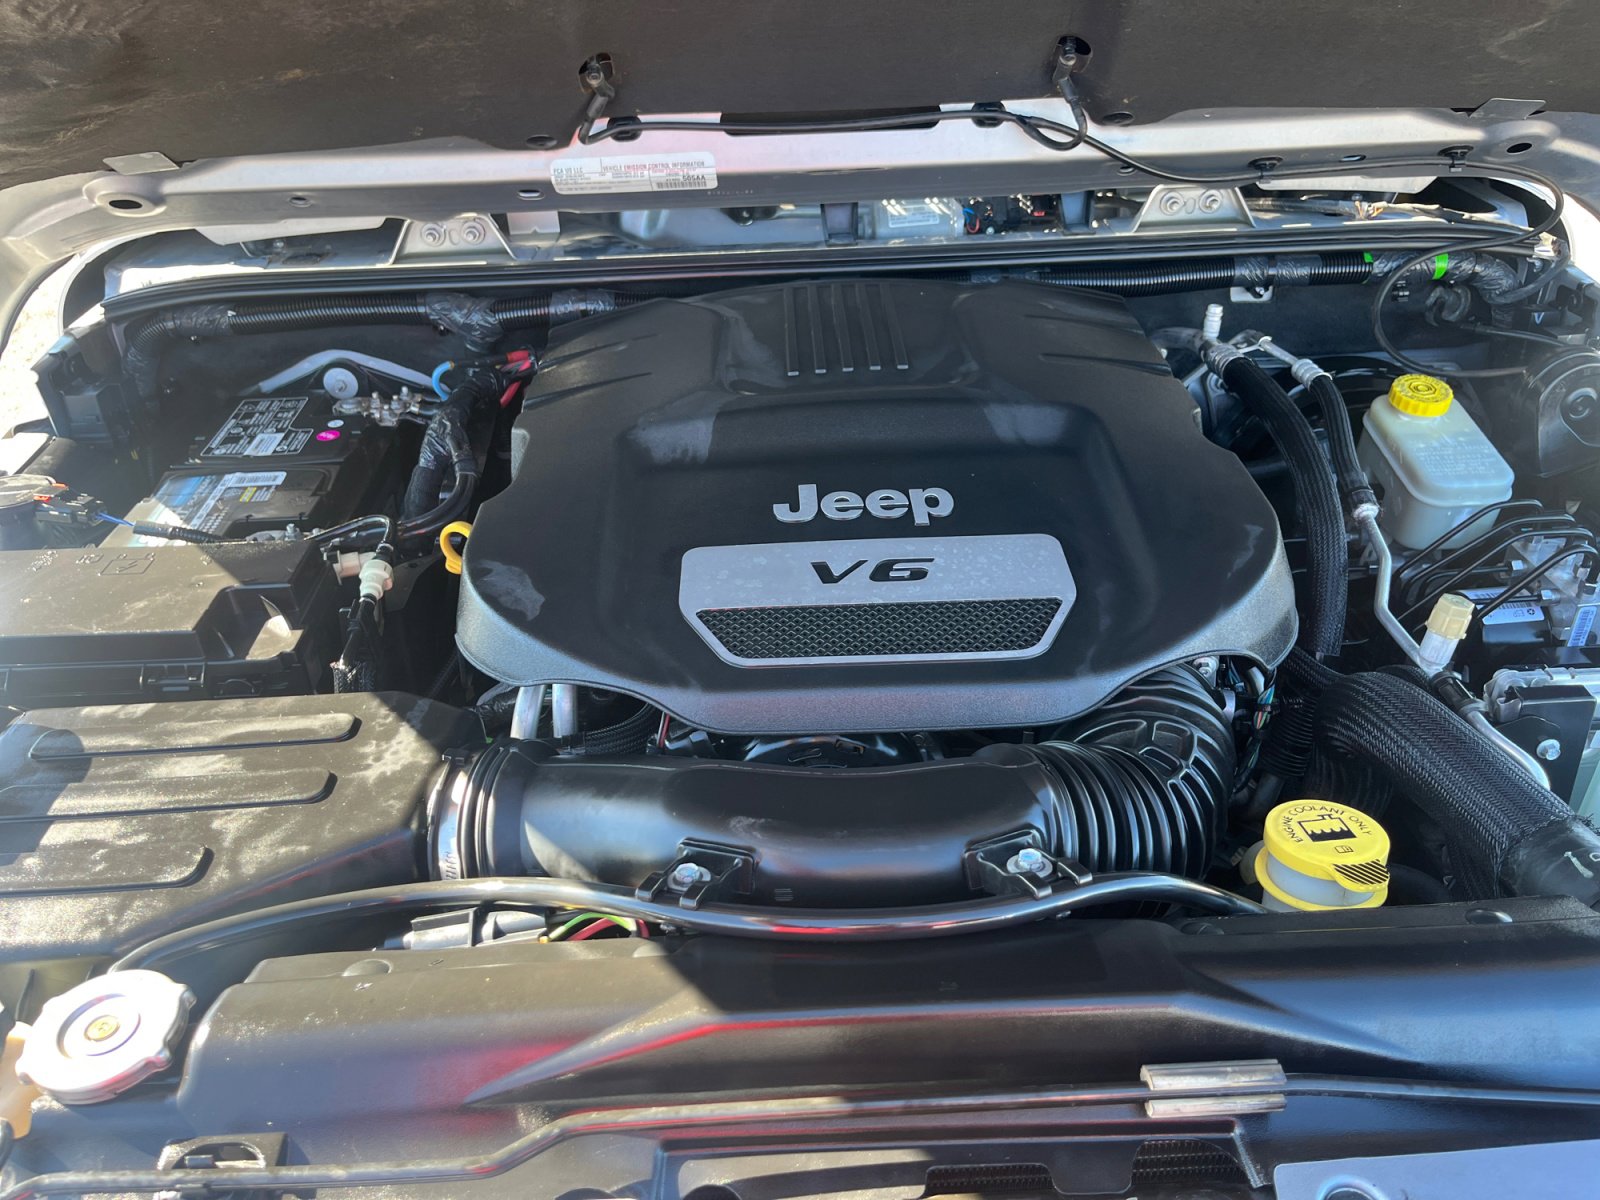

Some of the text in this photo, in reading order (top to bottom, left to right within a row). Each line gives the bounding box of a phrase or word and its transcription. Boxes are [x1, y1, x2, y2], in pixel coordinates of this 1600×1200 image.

[773, 484, 954, 526] Jeep
[811, 558, 935, 584] V6
[1283, 805, 1372, 844] ENGINE COOLANT ONLY
